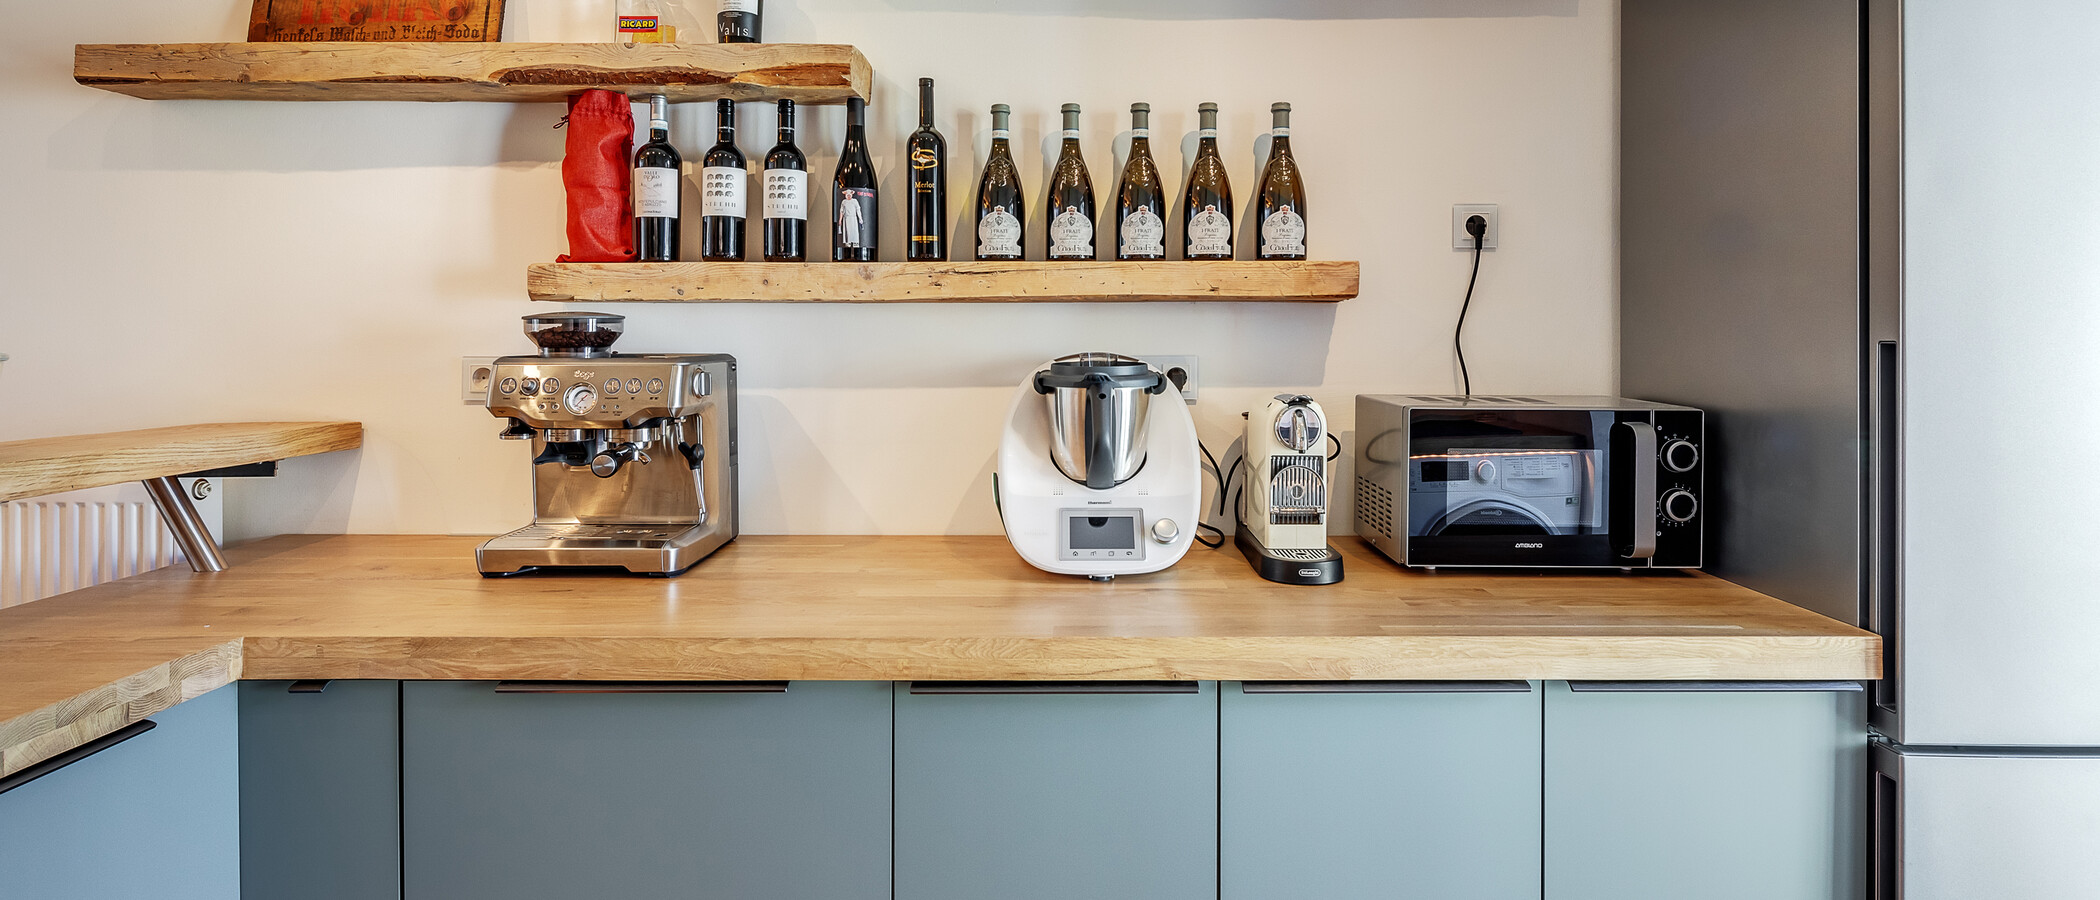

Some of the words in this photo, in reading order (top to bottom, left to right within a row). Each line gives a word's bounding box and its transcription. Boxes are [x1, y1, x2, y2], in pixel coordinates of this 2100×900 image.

[620, 19, 655, 28] RICARD
[444, 24, 480, 39] Soda
[914, 181, 935, 189] Merlot
